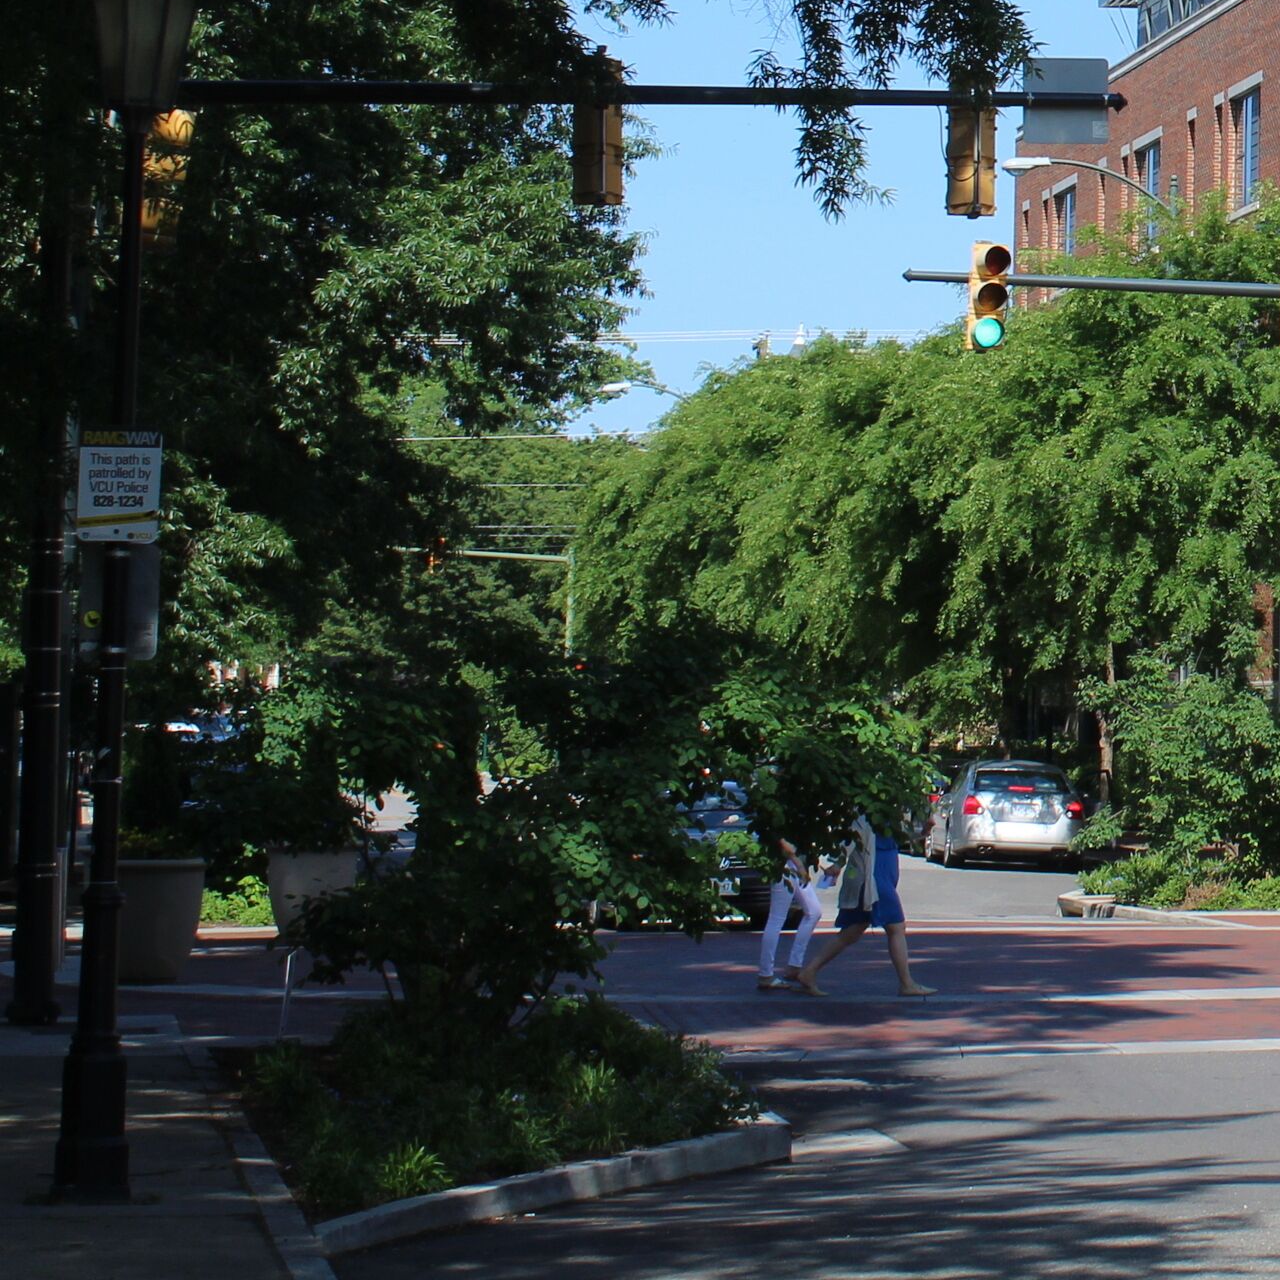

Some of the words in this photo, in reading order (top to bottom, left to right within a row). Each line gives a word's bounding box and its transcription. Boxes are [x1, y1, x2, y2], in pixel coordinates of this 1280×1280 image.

[90, 453, 113, 465] This
[115, 453, 140, 467] path
[142, 453, 151, 465] is
[88, 467, 136, 480] patrolled
[138, 467, 152, 481] by
[90, 481, 114, 493] VCU
[117, 481, 149, 493] Police
[93, 495, 144, 507] 828-1234
